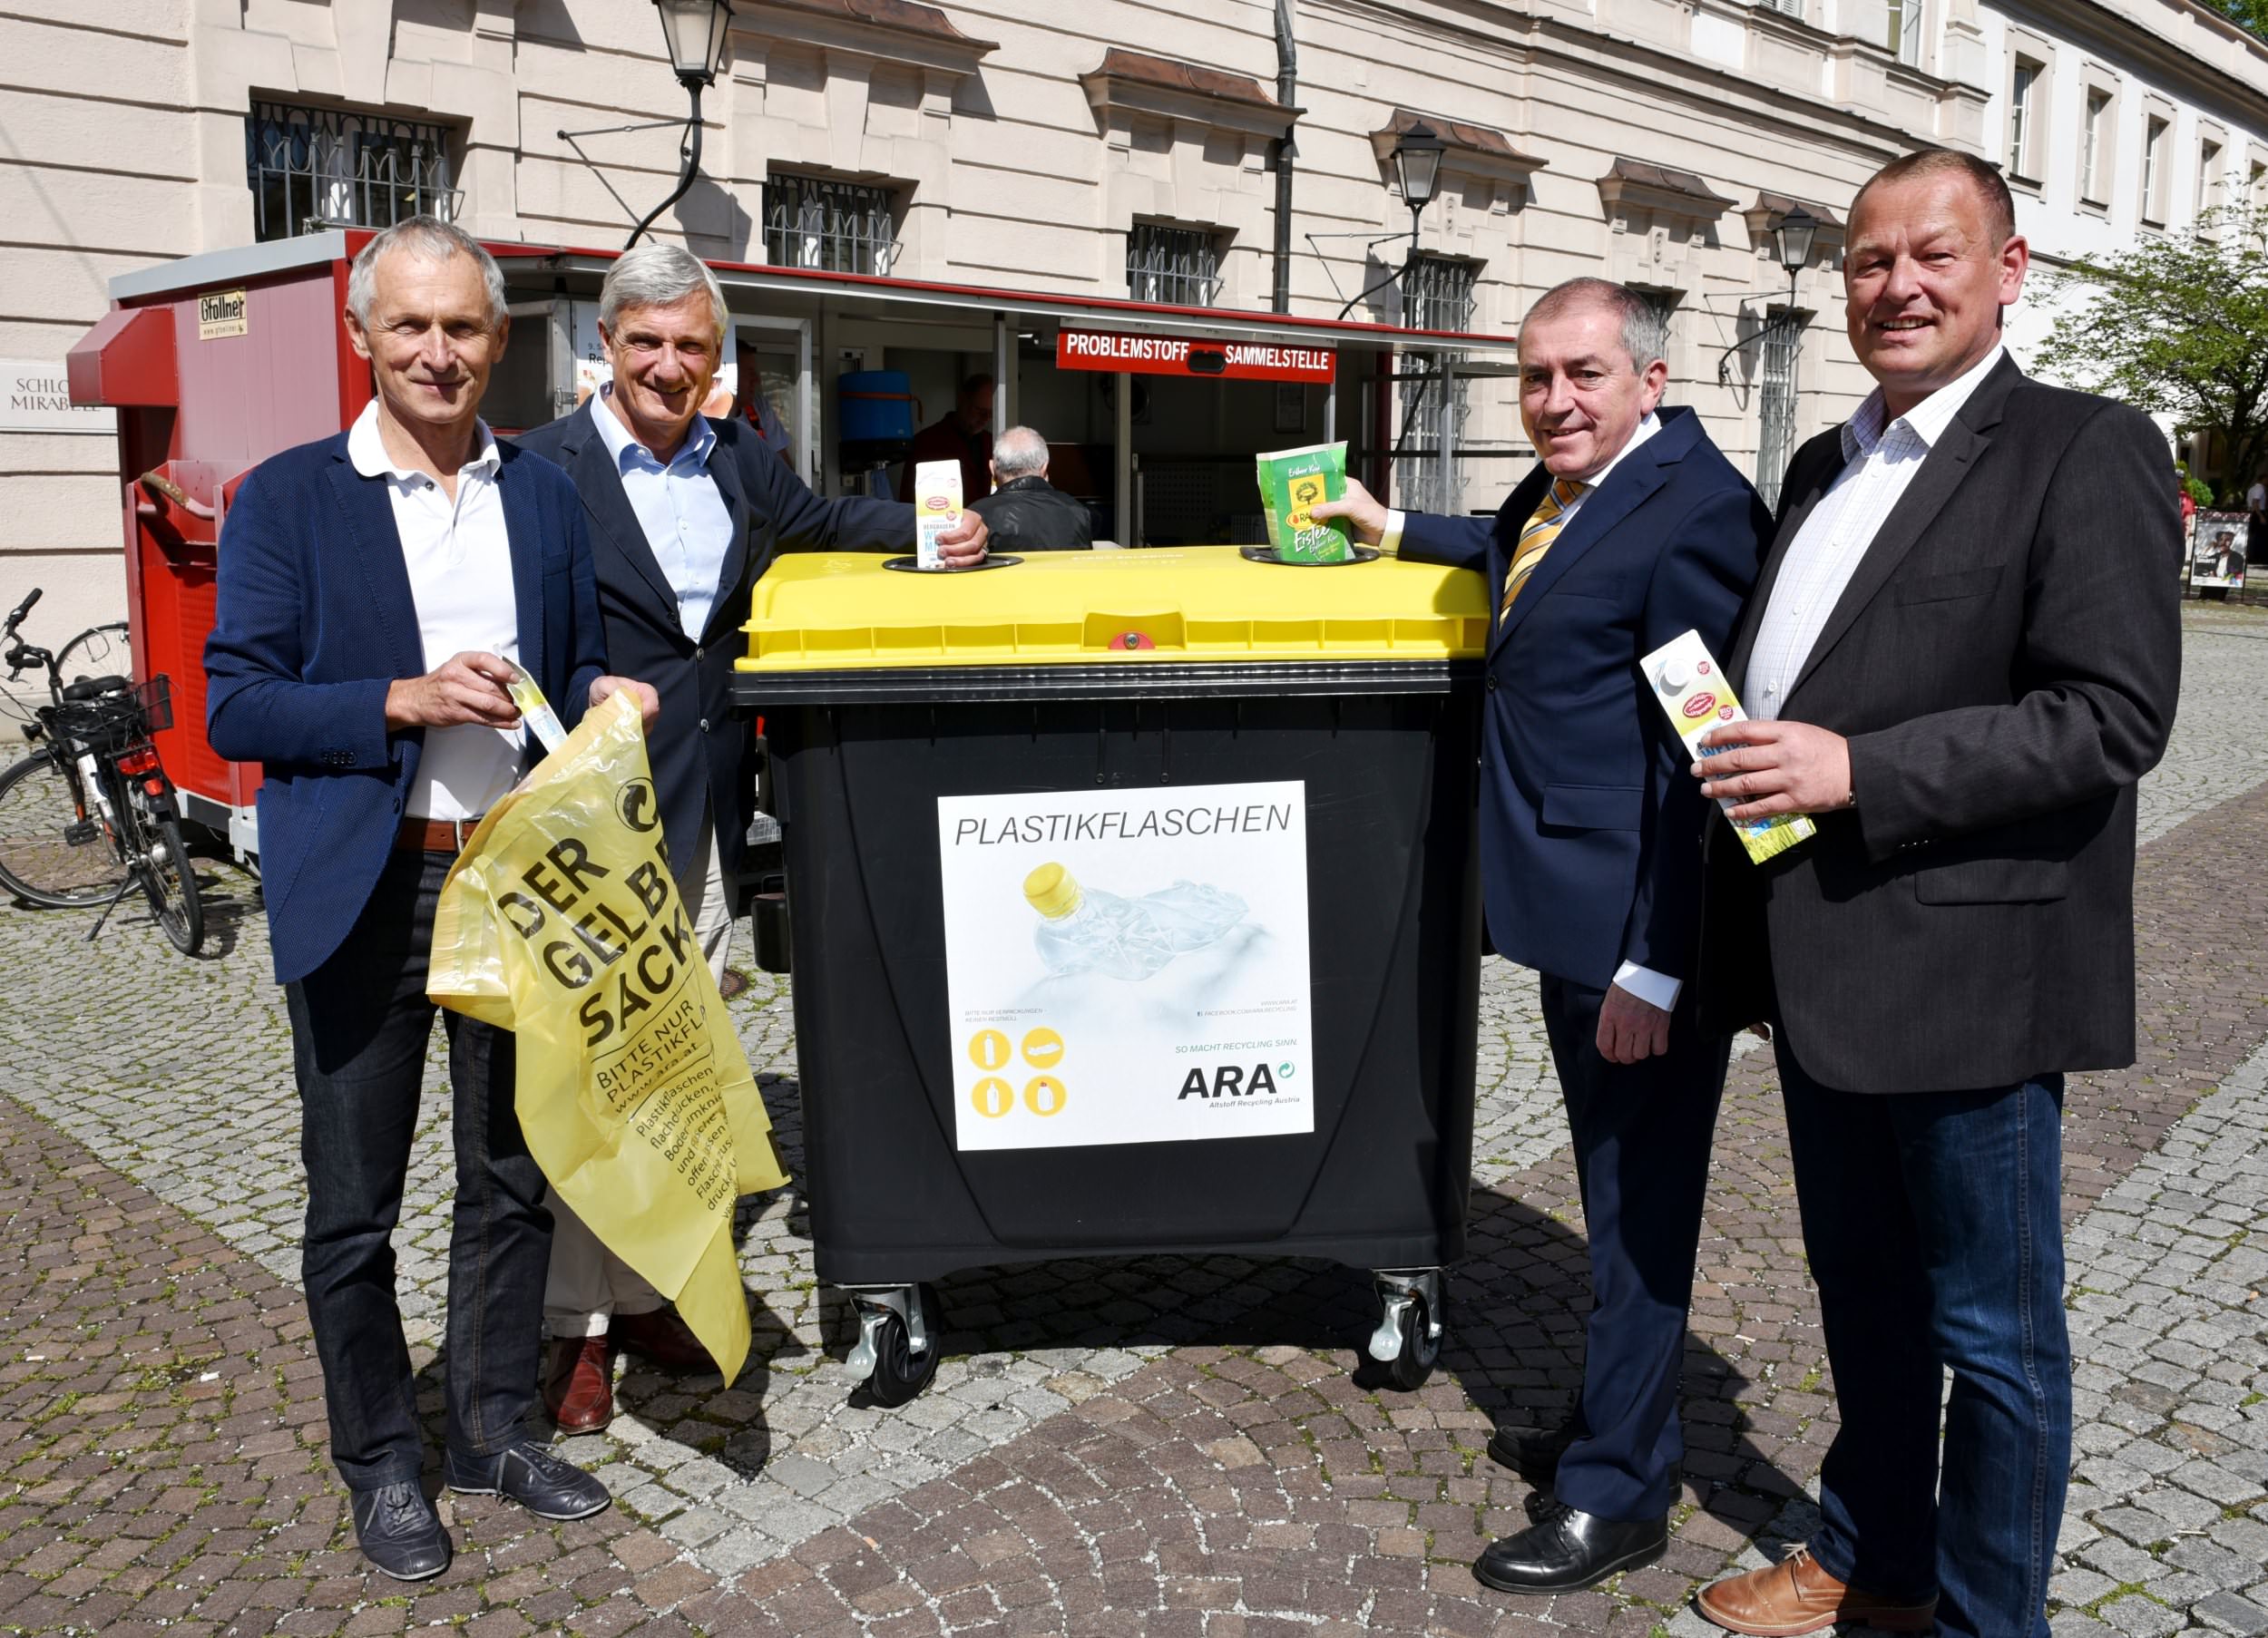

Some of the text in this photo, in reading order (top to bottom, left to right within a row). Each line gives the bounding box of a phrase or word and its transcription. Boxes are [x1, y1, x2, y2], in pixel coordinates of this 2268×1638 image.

[200, 295, 245, 321] Gföllner
[1066, 333, 1330, 370] PROBLEMSTOFF SAMMELSTELLE
[11, 395, 101, 412] MIRAB
[1717, 707, 1732, 717] BIO
[955, 804, 1292, 845] PLASTIKFLASCHEN
[497, 838, 611, 940] DER
[543, 836, 680, 990] GELB
[579, 902, 691, 1048] SACK
[596, 999, 694, 1089] BITTE NUR
[1176, 1038, 1298, 1053] SO MACHT RECYCLING SINN.
[616, 1043, 699, 1115] www.ara.at
[1178, 1063, 1276, 1100] ARA
[636, 1067, 714, 1137] Plastikflaschen
[1208, 1100, 1236, 1108] Altstoff
[1237, 1098, 1273, 1107] Recycling
[677, 1149, 696, 1175] und
[688, 1155, 709, 1187] offen
